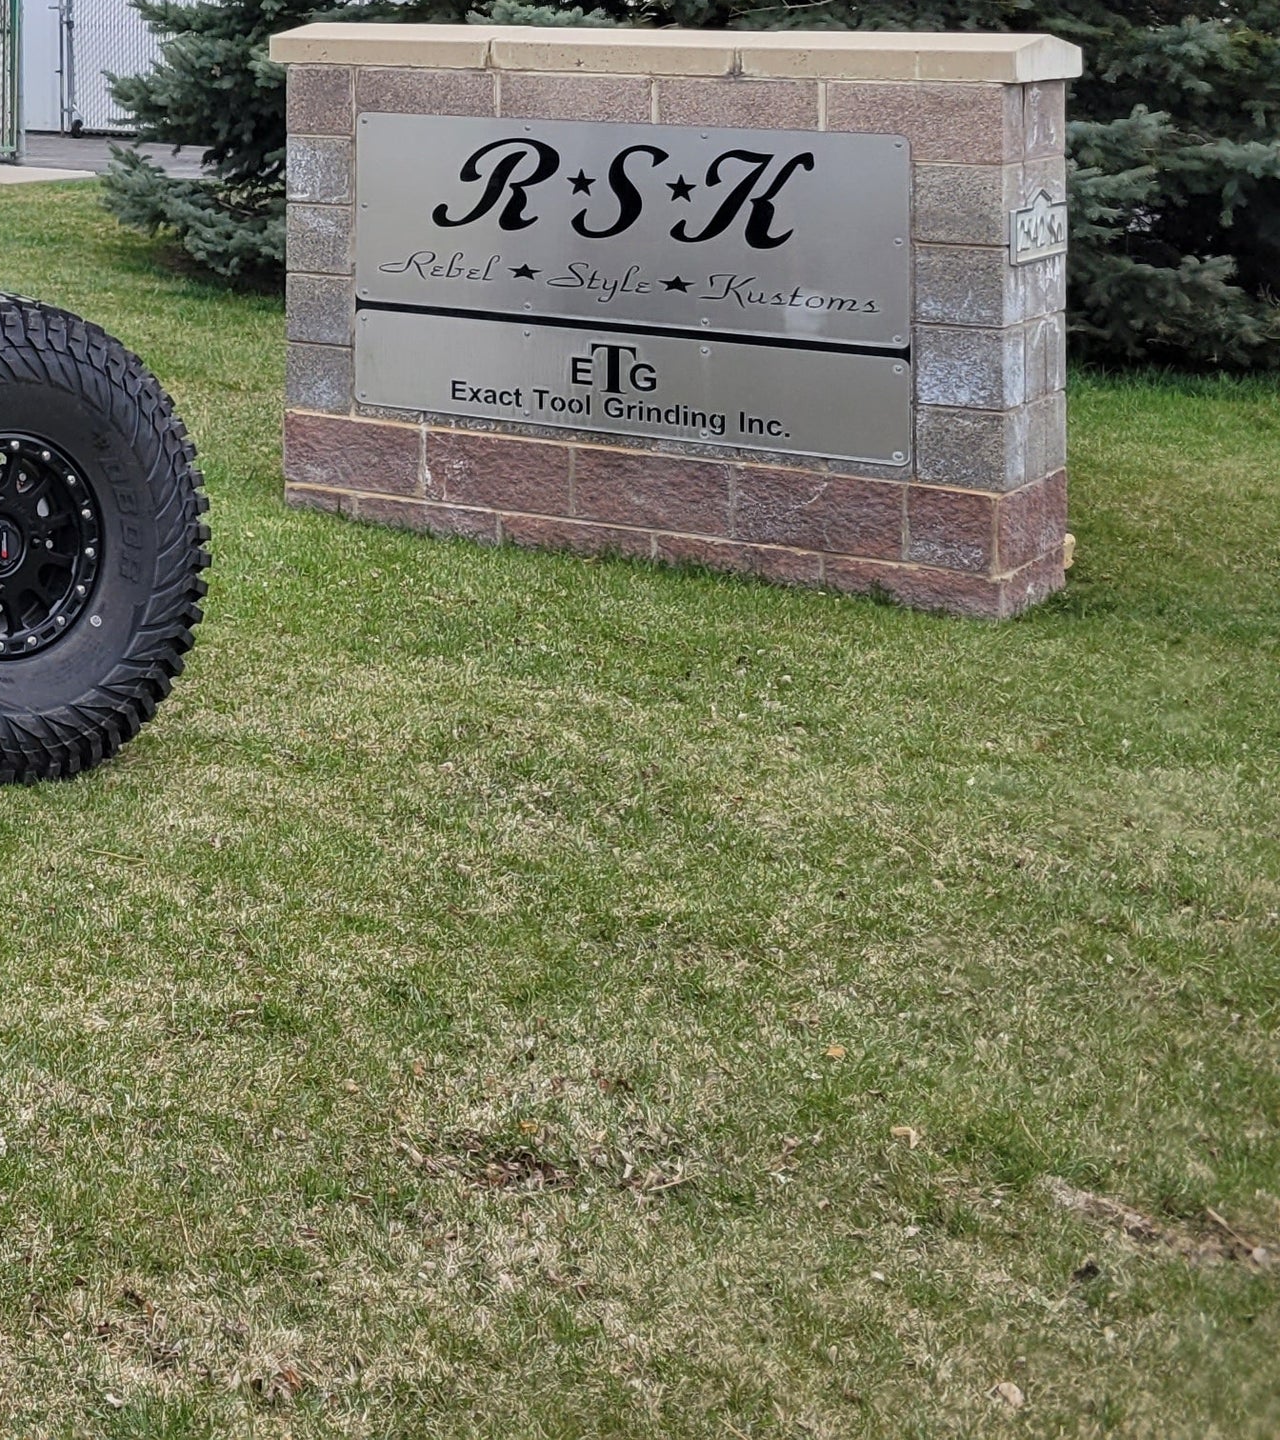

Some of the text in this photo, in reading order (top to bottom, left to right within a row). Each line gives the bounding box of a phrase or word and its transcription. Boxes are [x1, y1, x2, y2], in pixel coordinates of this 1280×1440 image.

[377, 250, 881, 314] Rebel Style Kustoms
[570, 342, 659, 395] ETG
[450, 380, 792, 439] Exact Tool Grinding Inc.
